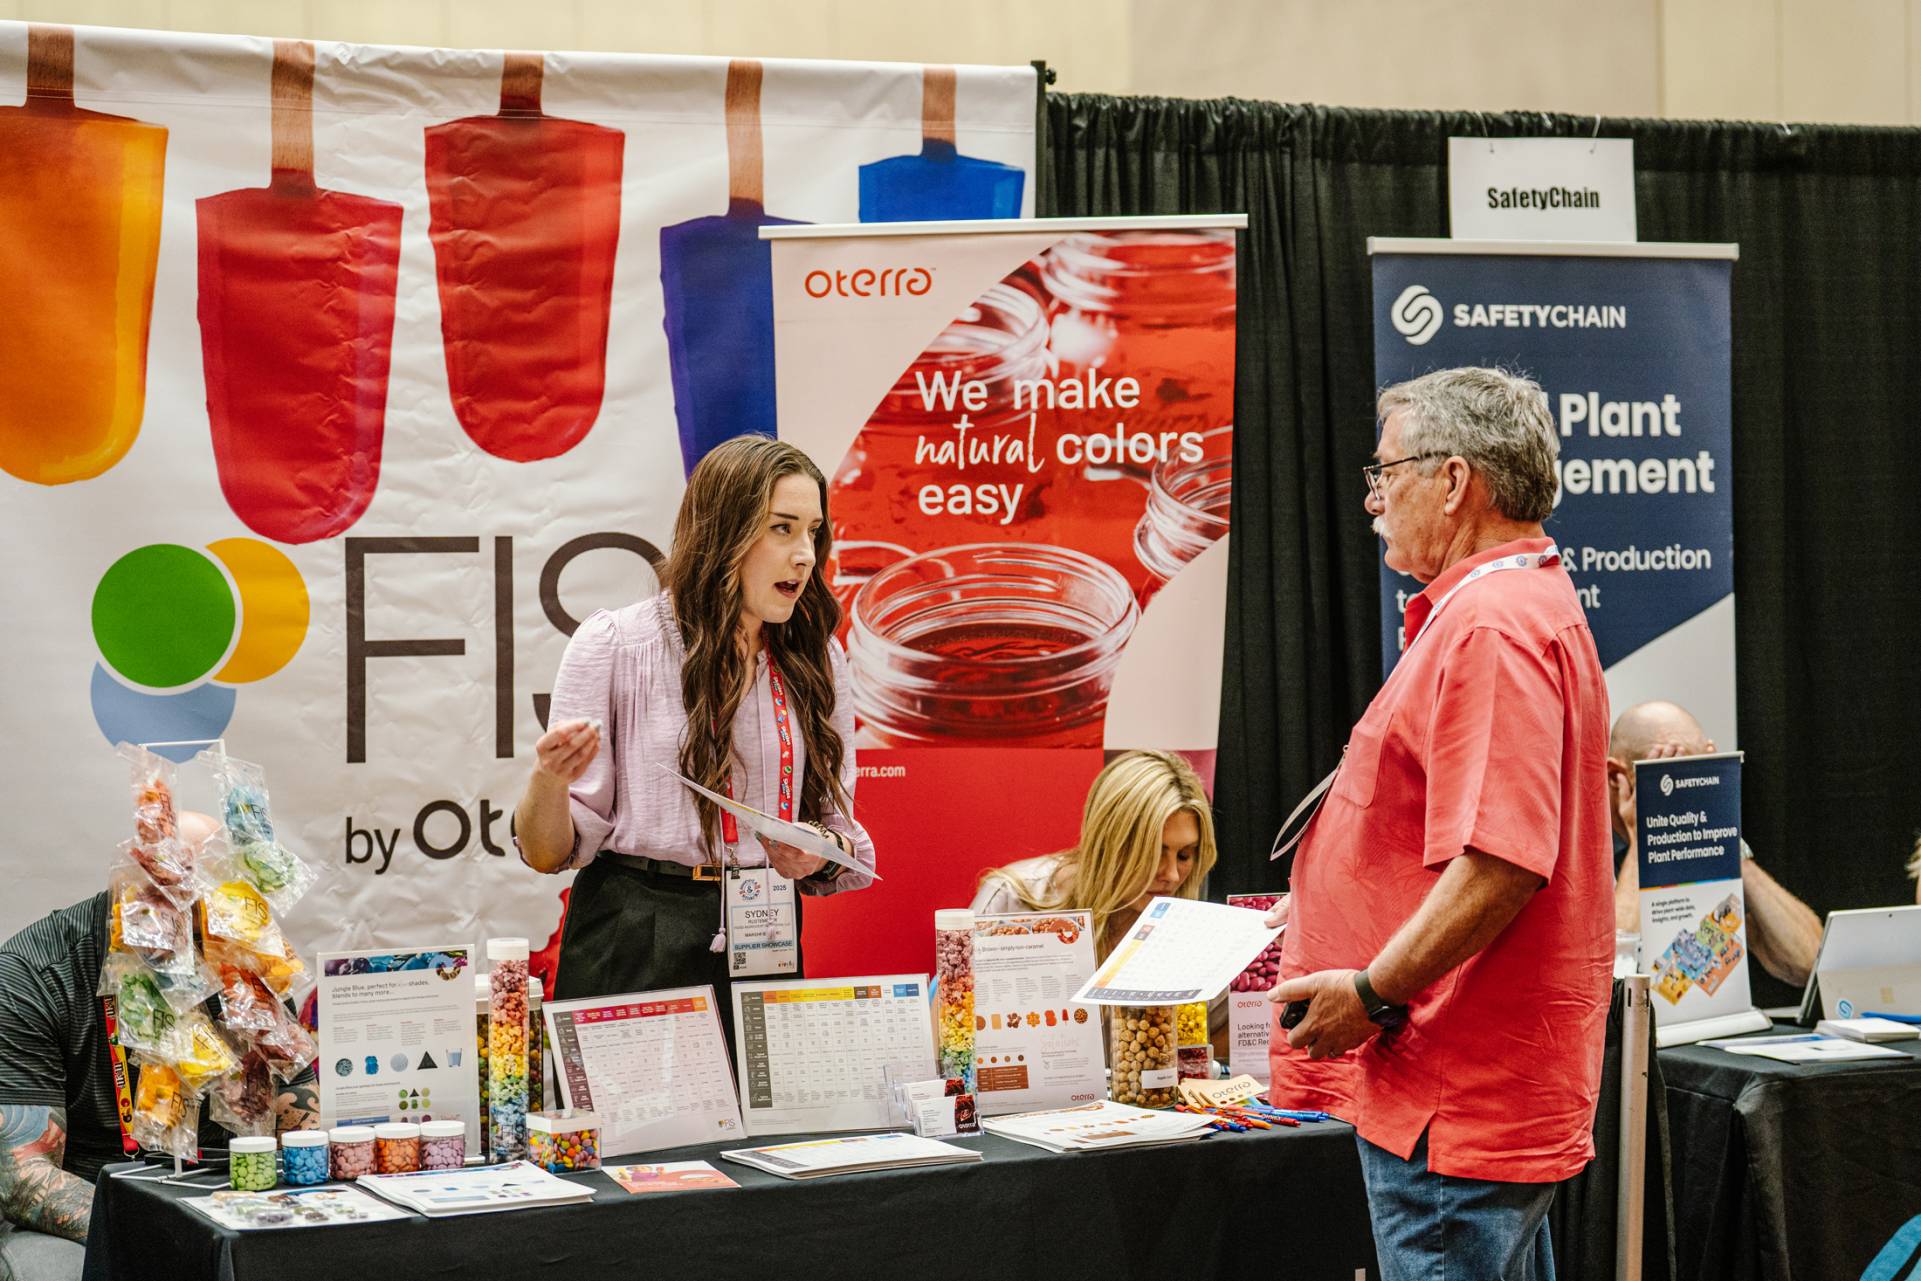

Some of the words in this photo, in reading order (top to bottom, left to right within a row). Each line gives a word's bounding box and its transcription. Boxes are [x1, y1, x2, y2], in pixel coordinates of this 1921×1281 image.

[1487, 187, 1600, 210] SafetyChain
[1453, 304, 1627, 330] SAFETYCHAIN
[915, 370, 988, 411] We
[1013, 368, 1140, 410] make
[1560, 392, 1682, 437] Plant
[915, 413, 1045, 473] natural
[1056, 422, 1204, 464] colors
[917, 483, 1024, 525] easy
[1561, 547, 1577, 571] &
[1582, 544, 1713, 571] Production
[1675, 776, 1720, 789] SAFETYCHAIN
[1646, 815, 1669, 828] Unite
[1669, 811, 1699, 827] Quality
[1700, 811, 1707, 822] &
[345, 816, 401, 875] by
[1647, 830, 1692, 846] Production
[1693, 830, 1702, 840] to
[1702, 827, 1738, 842] Improve
[1648, 850, 1671, 864] Plant
[1671, 845, 1725, 861] Performance
[745, 909, 779, 918] SYDNEY
[734, 943, 760, 951] SUPPLIER
[761, 941, 793, 949] SHOWCASE
[1238, 1022, 1265, 1031] Looking
